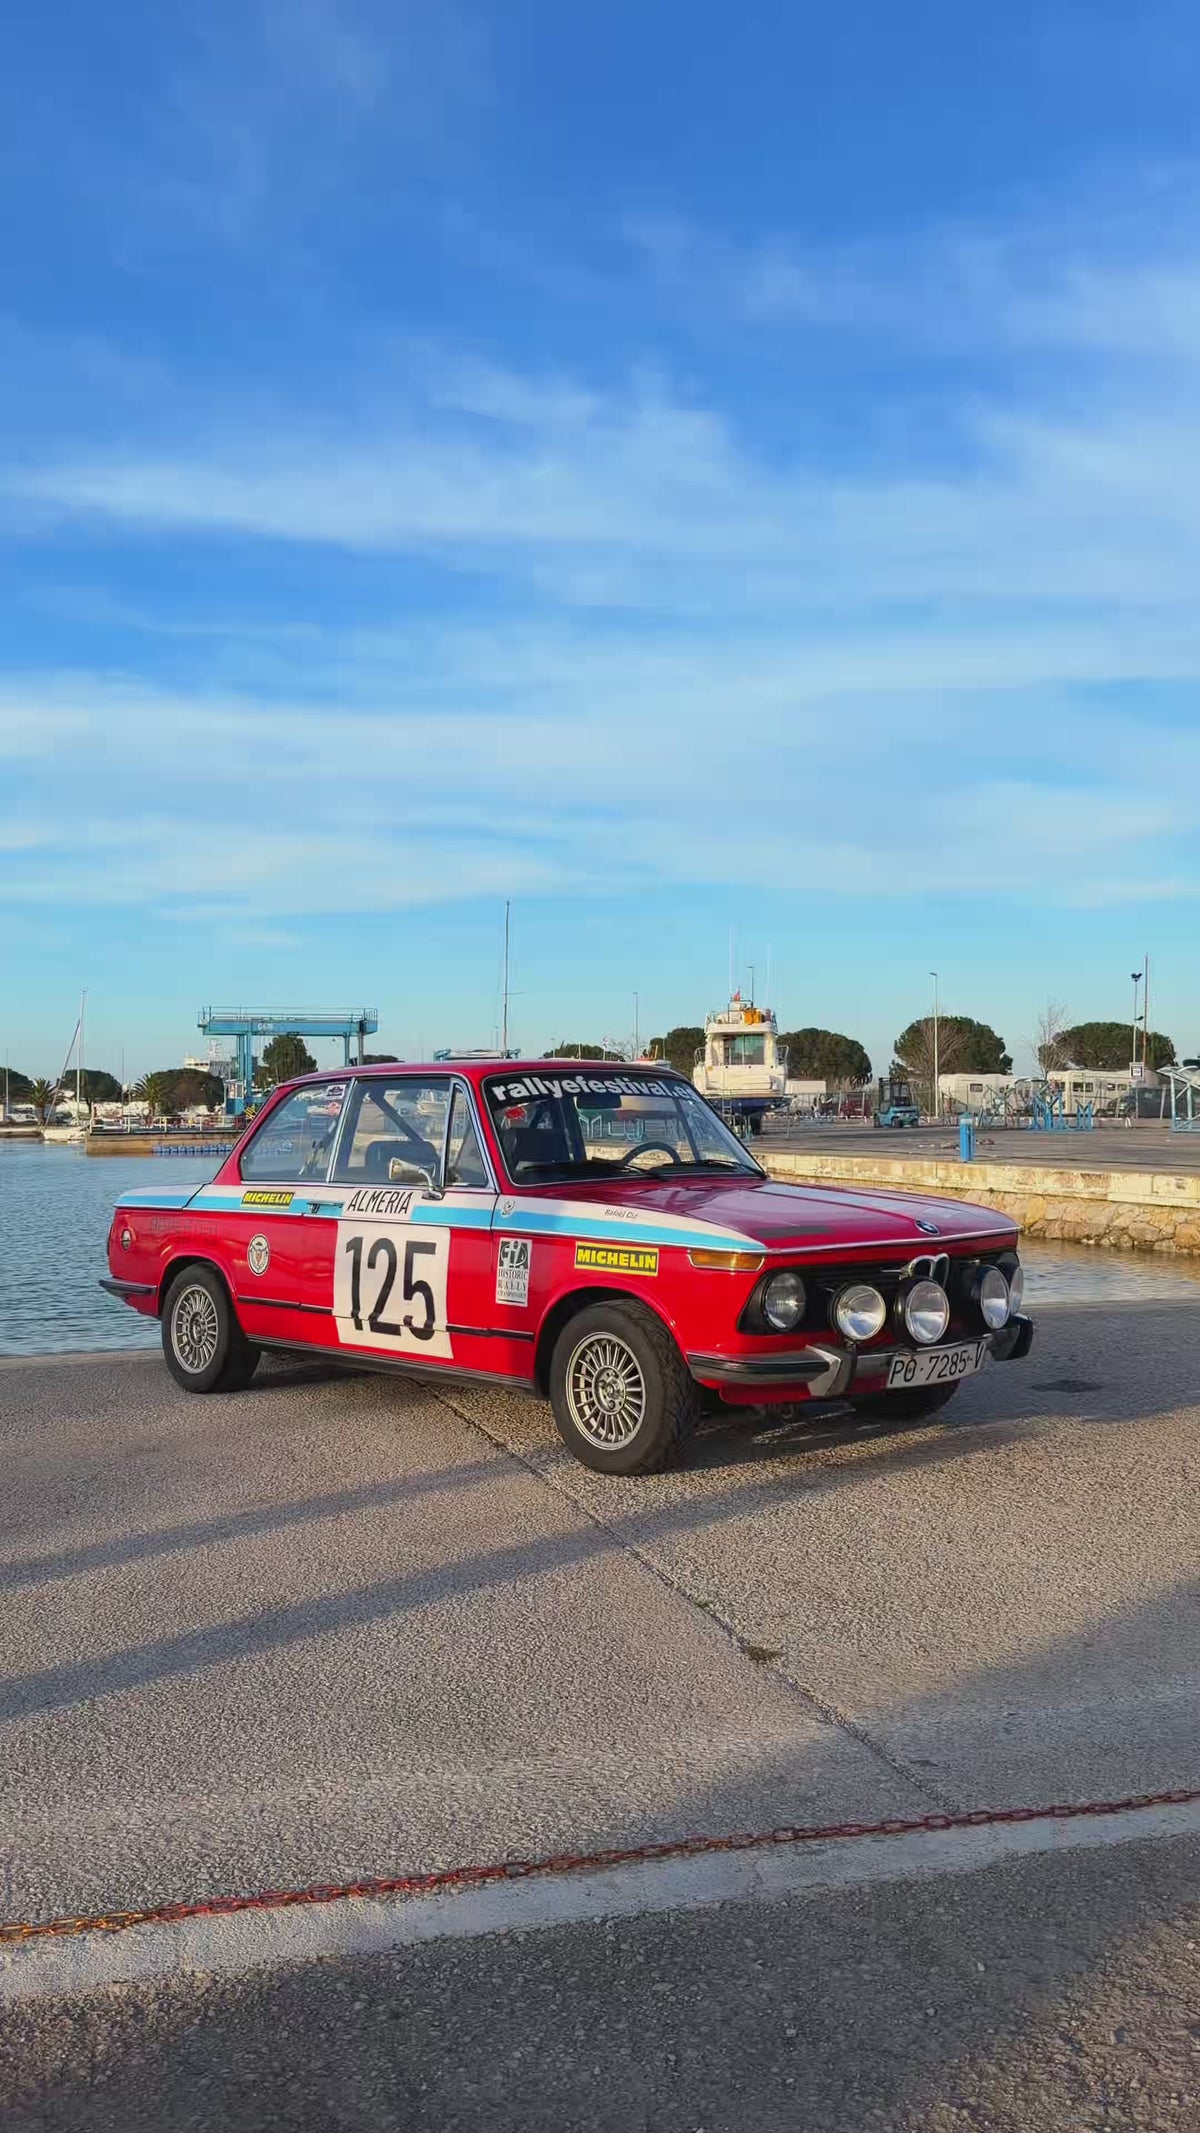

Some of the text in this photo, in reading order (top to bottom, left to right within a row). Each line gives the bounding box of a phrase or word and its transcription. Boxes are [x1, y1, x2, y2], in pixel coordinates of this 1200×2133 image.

[243, 1192, 293, 1204] MICHELIN
[347, 1190, 414, 1214] ALMERIA
[577, 1248, 657, 1270] MICHELIN
[498, 1269, 528, 1280] HISTORIC
[346, 1236, 437, 1341] 125
[497, 1279, 527, 1292] RALLY
